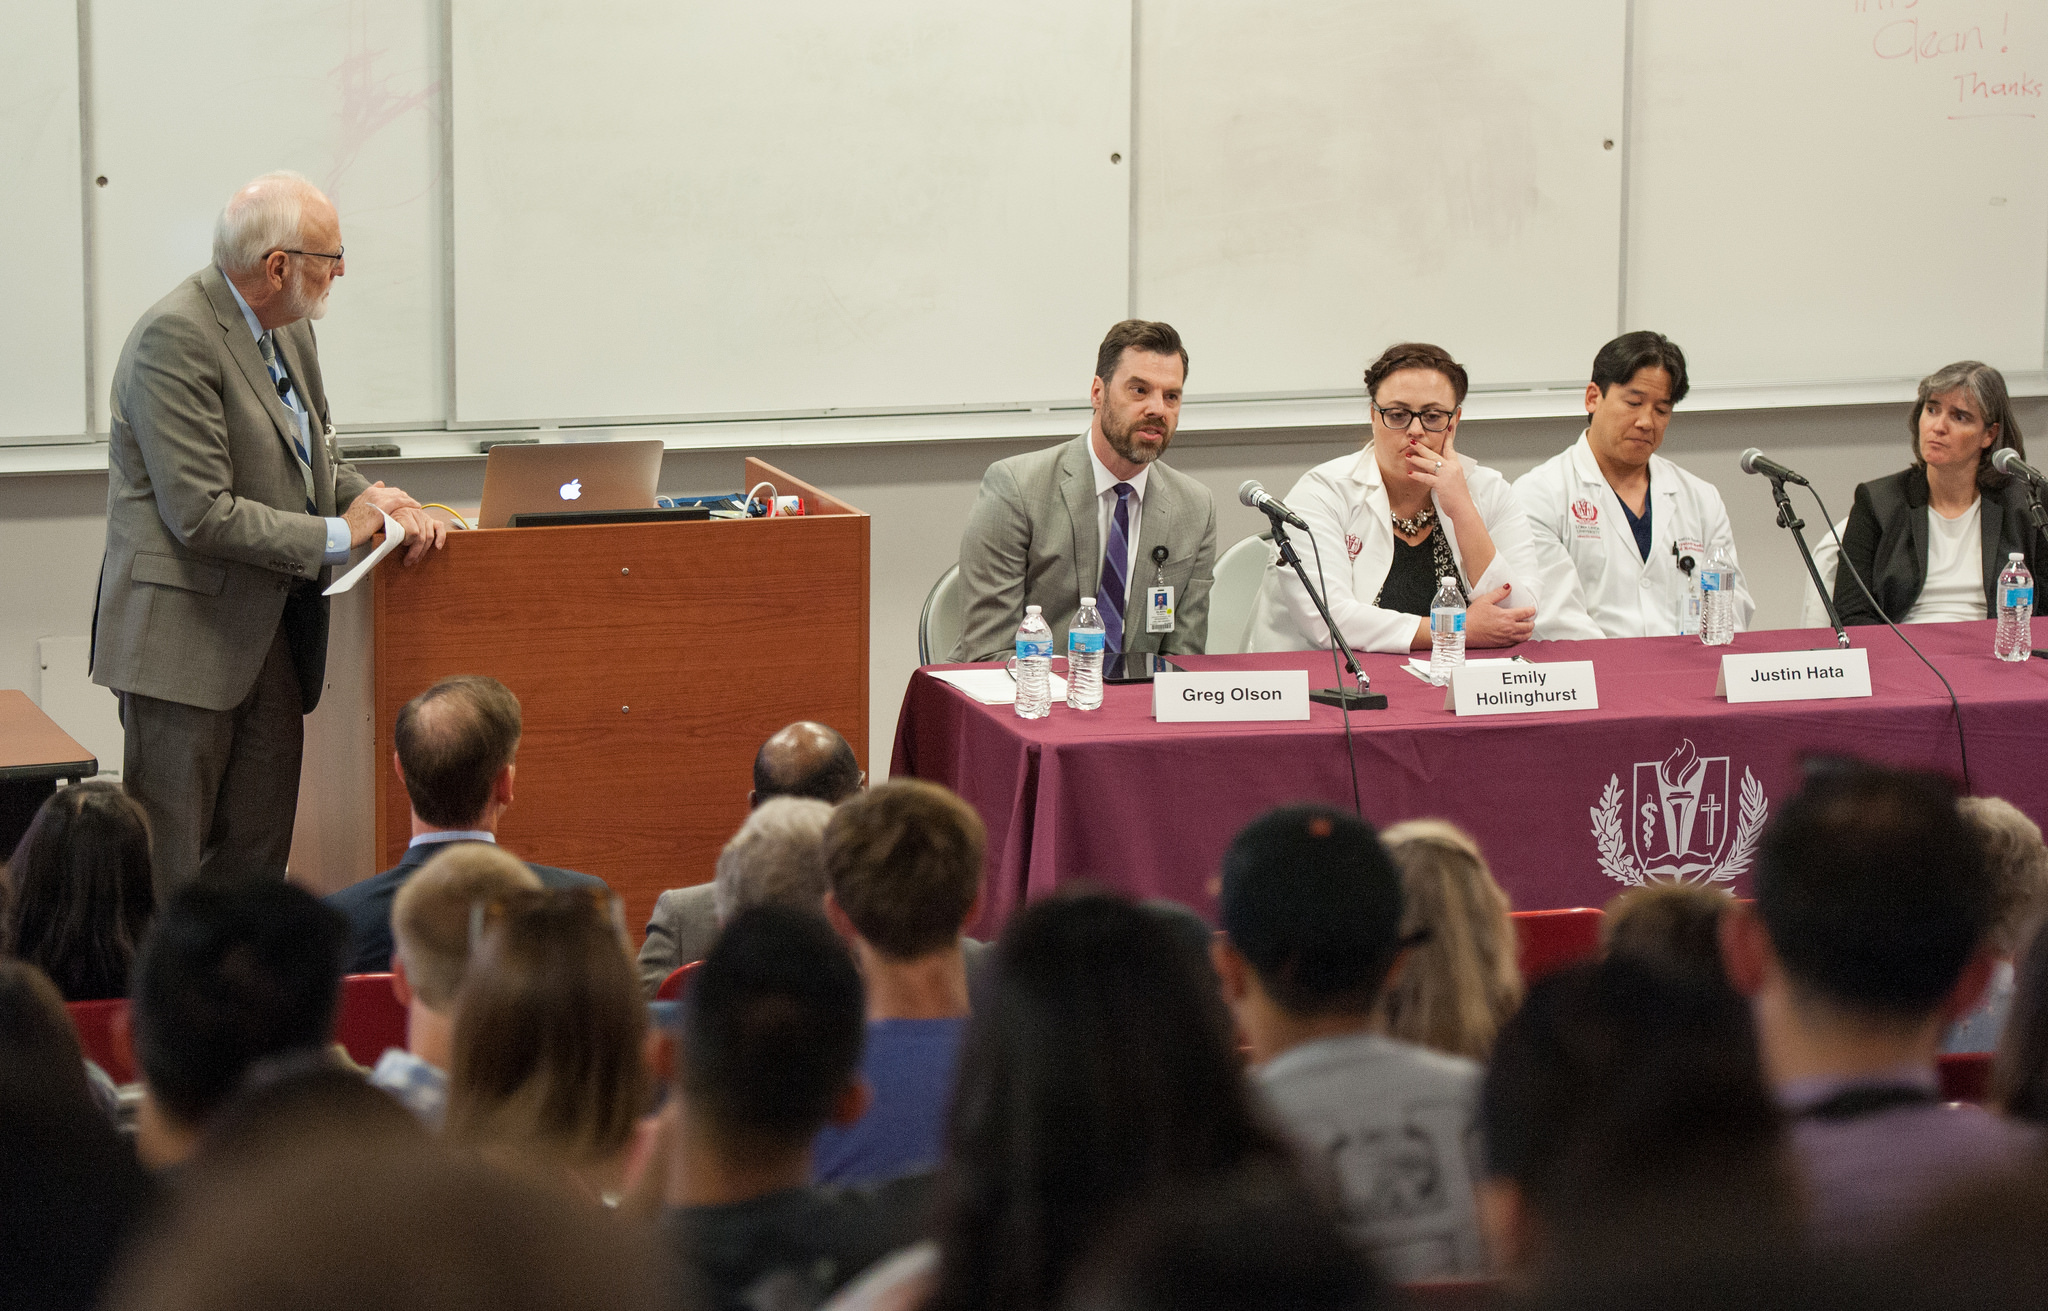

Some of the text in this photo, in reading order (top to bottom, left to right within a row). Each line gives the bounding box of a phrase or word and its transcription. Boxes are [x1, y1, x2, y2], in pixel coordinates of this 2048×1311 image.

[1953, 72, 2043, 103] Thanks
[1501, 670, 1548, 687] Emily
[1750, 666, 1844, 683] Justin Hata
[1182, 687, 1282, 705] Greg Olson
[1476, 689, 1577, 707] Hollinghurst
